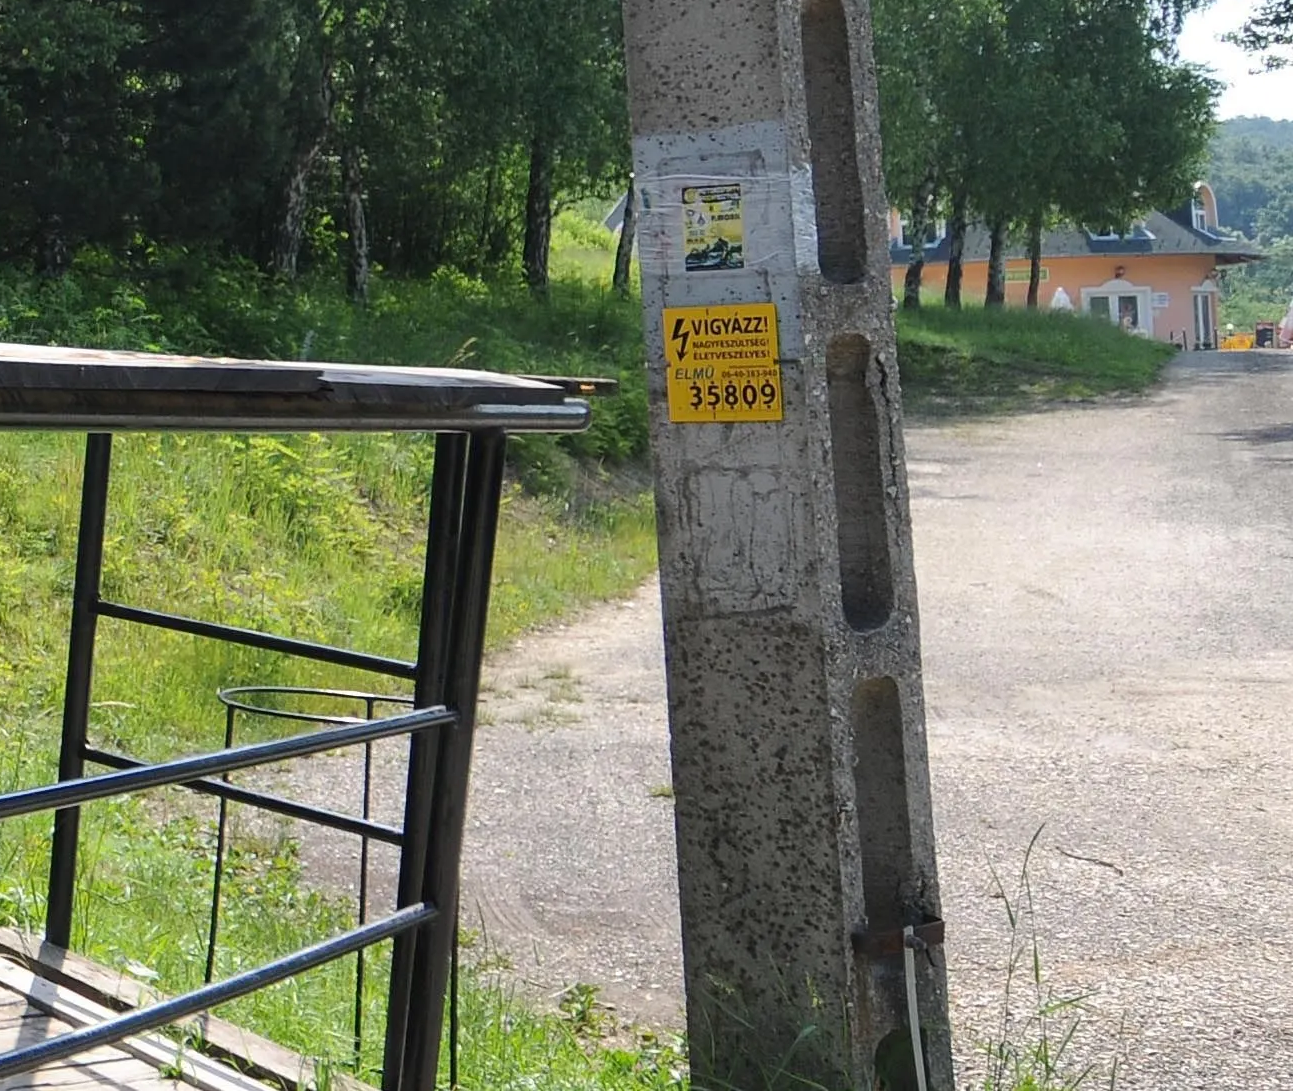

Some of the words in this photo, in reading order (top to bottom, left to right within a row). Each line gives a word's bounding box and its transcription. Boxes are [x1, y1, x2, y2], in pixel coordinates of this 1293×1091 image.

[691, 311, 769, 336] VIGYÁZZ!
[693, 349, 771, 361] ÉLETVESZÉLYES!
[689, 382, 776, 408] 35809
